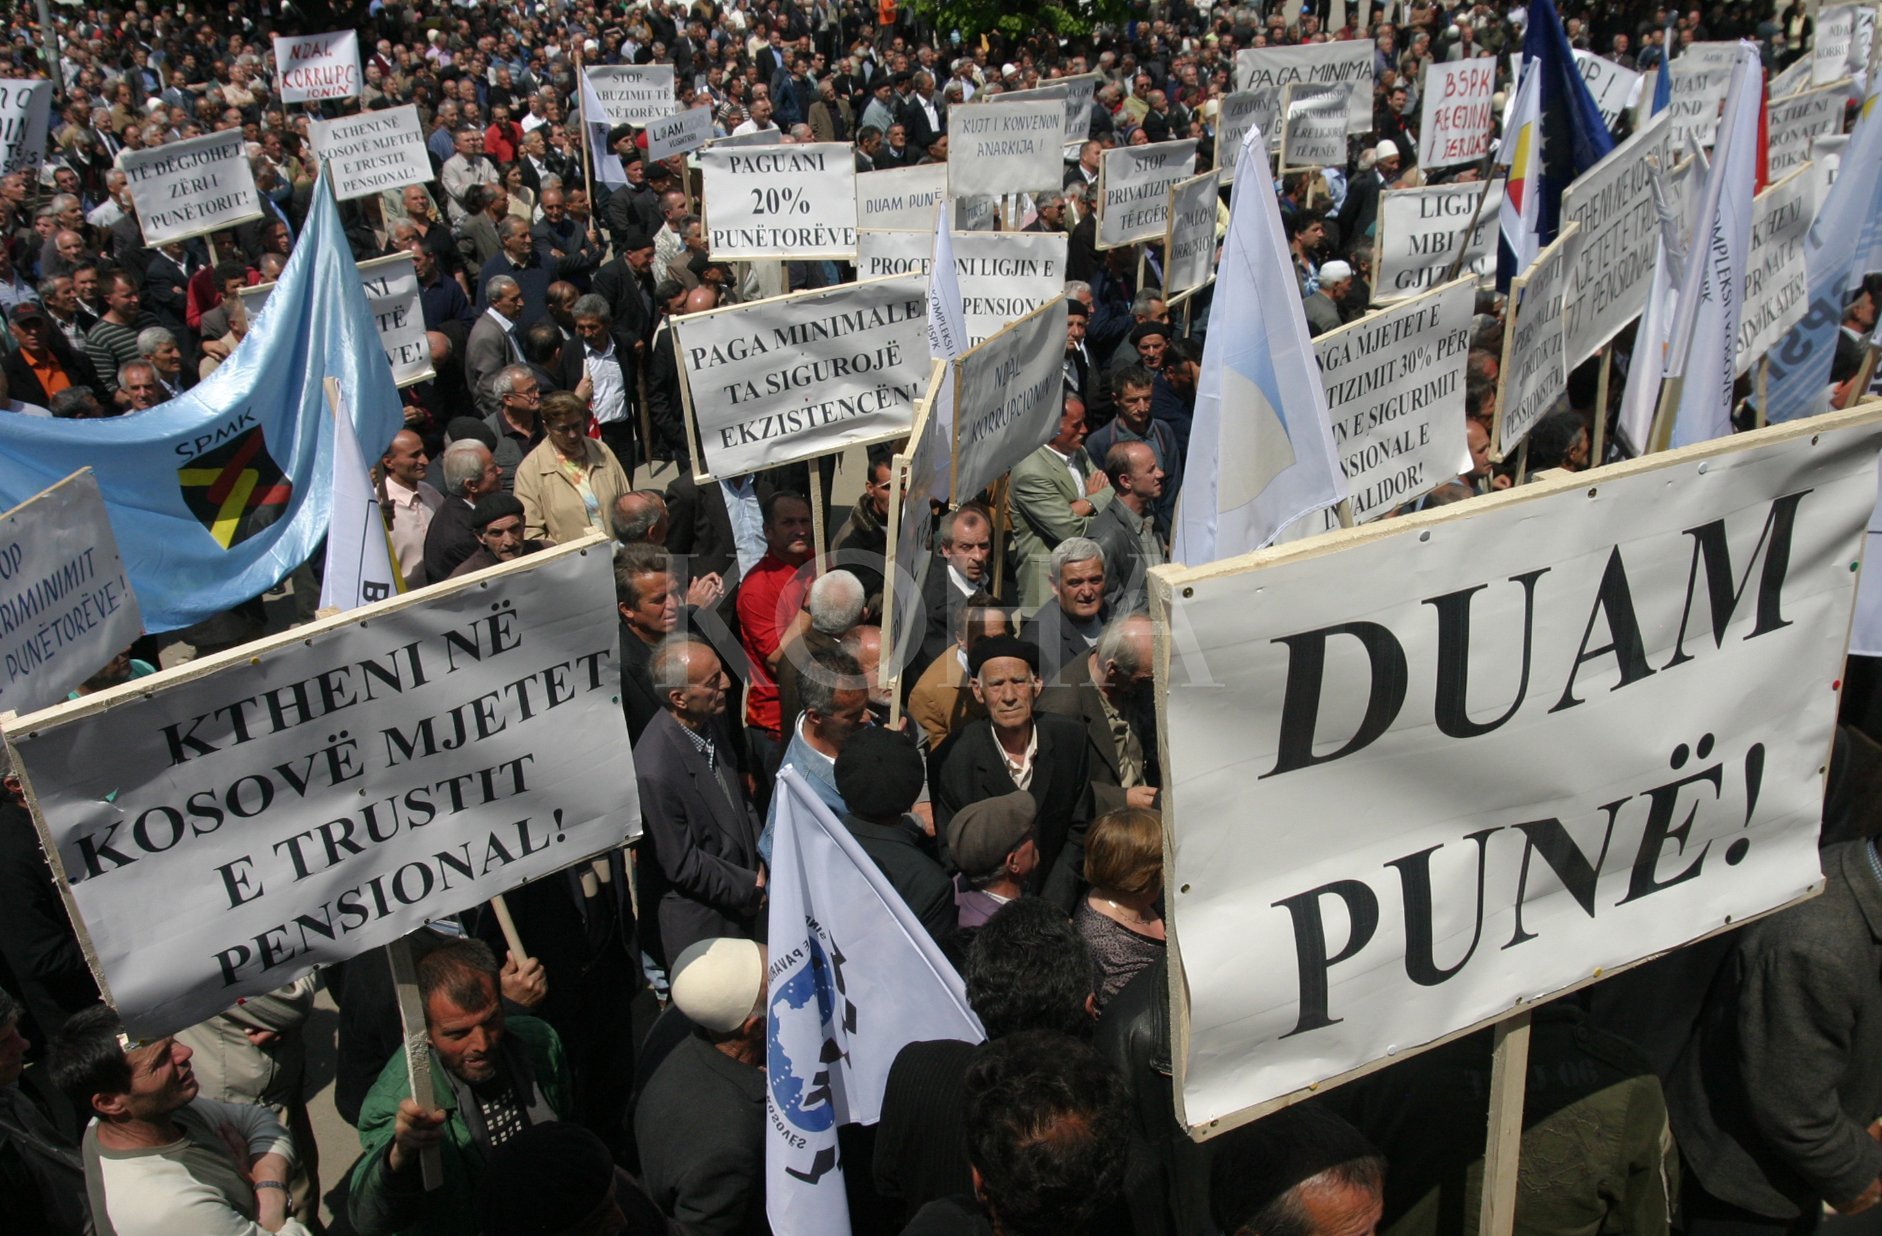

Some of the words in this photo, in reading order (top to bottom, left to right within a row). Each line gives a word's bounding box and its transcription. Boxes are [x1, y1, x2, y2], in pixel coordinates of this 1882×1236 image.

[289, 39, 333, 60] NDAL
[612, 73, 643, 84] STOP
[1248, 66, 1302, 89] PAGA
[1308, 59, 1373, 83] MINIMA
[1445, 68, 1492, 97] BSPK
[1670, 74, 1709, 94] UAM
[603, 105, 676, 118] NËTORËVE!
[963, 117, 991, 134] KUJT
[1002, 113, 1060, 132] KONVENON
[1670, 100, 1703, 119] OND
[331, 121, 380, 141] KTHENI
[382, 114, 400, 130] NË
[317, 138, 373, 162] KOSOVË
[372, 130, 423, 152] MJETET
[977, 140, 1035, 158] ANARKIJA
[129, 160, 151, 183] TË
[154, 141, 242, 177] DËGJOHET
[343, 163, 351, 175] E
[353, 151, 407, 173] TRUSTIT
[728, 152, 826, 174] PAGUANI
[1135, 153, 1168, 173] STOP
[169, 176, 209, 199] ZËRI
[342, 167, 418, 193] PENSIONAL!
[150, 190, 250, 230] PUNËTORIT!
[750, 186, 811, 216] 20%
[866, 196, 903, 214] DUAM
[908, 186, 944, 208] PUNË
[1120, 210, 1134, 231] TË
[1135, 204, 1169, 226] EGËR
[712, 222, 856, 248] PUNËTORËVE
[1407, 230, 1455, 257] MBI
[980, 258, 1040, 277] LIGJIN
[1043, 260, 1054, 278] E
[1711, 207, 1733, 307] OMPLEKSI
[363, 276, 392, 301] NI
[375, 305, 407, 333] TË
[1355, 309, 1428, 361] MJETET
[1429, 303, 1441, 328] E
[689, 333, 769, 371] PAGA
[772, 299, 922, 350] MINIMALE
[386, 341, 424, 368] VE!
[1326, 357, 1399, 411] TIZIMIT
[1399, 343, 1432, 378] 30%
[1436, 328, 1468, 367] PËR
[723, 379, 762, 406] TA
[765, 340, 904, 396] SIGUROJË
[719, 381, 920, 450] EKZISTENCËN!
[1332, 418, 1348, 446] IN
[1352, 411, 1365, 437] E
[1368, 368, 1460, 430] SIGURIMIT
[174, 406, 257, 462] SPMK
[1339, 426, 1416, 481] NSIONAL
[1323, 461, 1424, 531] INALIDOR!
[0, 542, 22, 580] OP
[0, 546, 94, 636] RIMINIMIT
[362, 578, 391, 603] B
[5, 580, 121, 684] PUNËTORËVE
[1258, 487, 1815, 781] DUAM
[159, 641, 432, 768] KTHENI
[440, 599, 523, 675] NË
[72, 729, 365, 883] KOSOVË
[379, 649, 611, 768] MJETET
[212, 855, 264, 911] E
[271, 752, 537, 884] TRUSTIT
[211, 807, 568, 989] PENSIONAL!
[1270, 732, 1767, 1041] PUNË!
